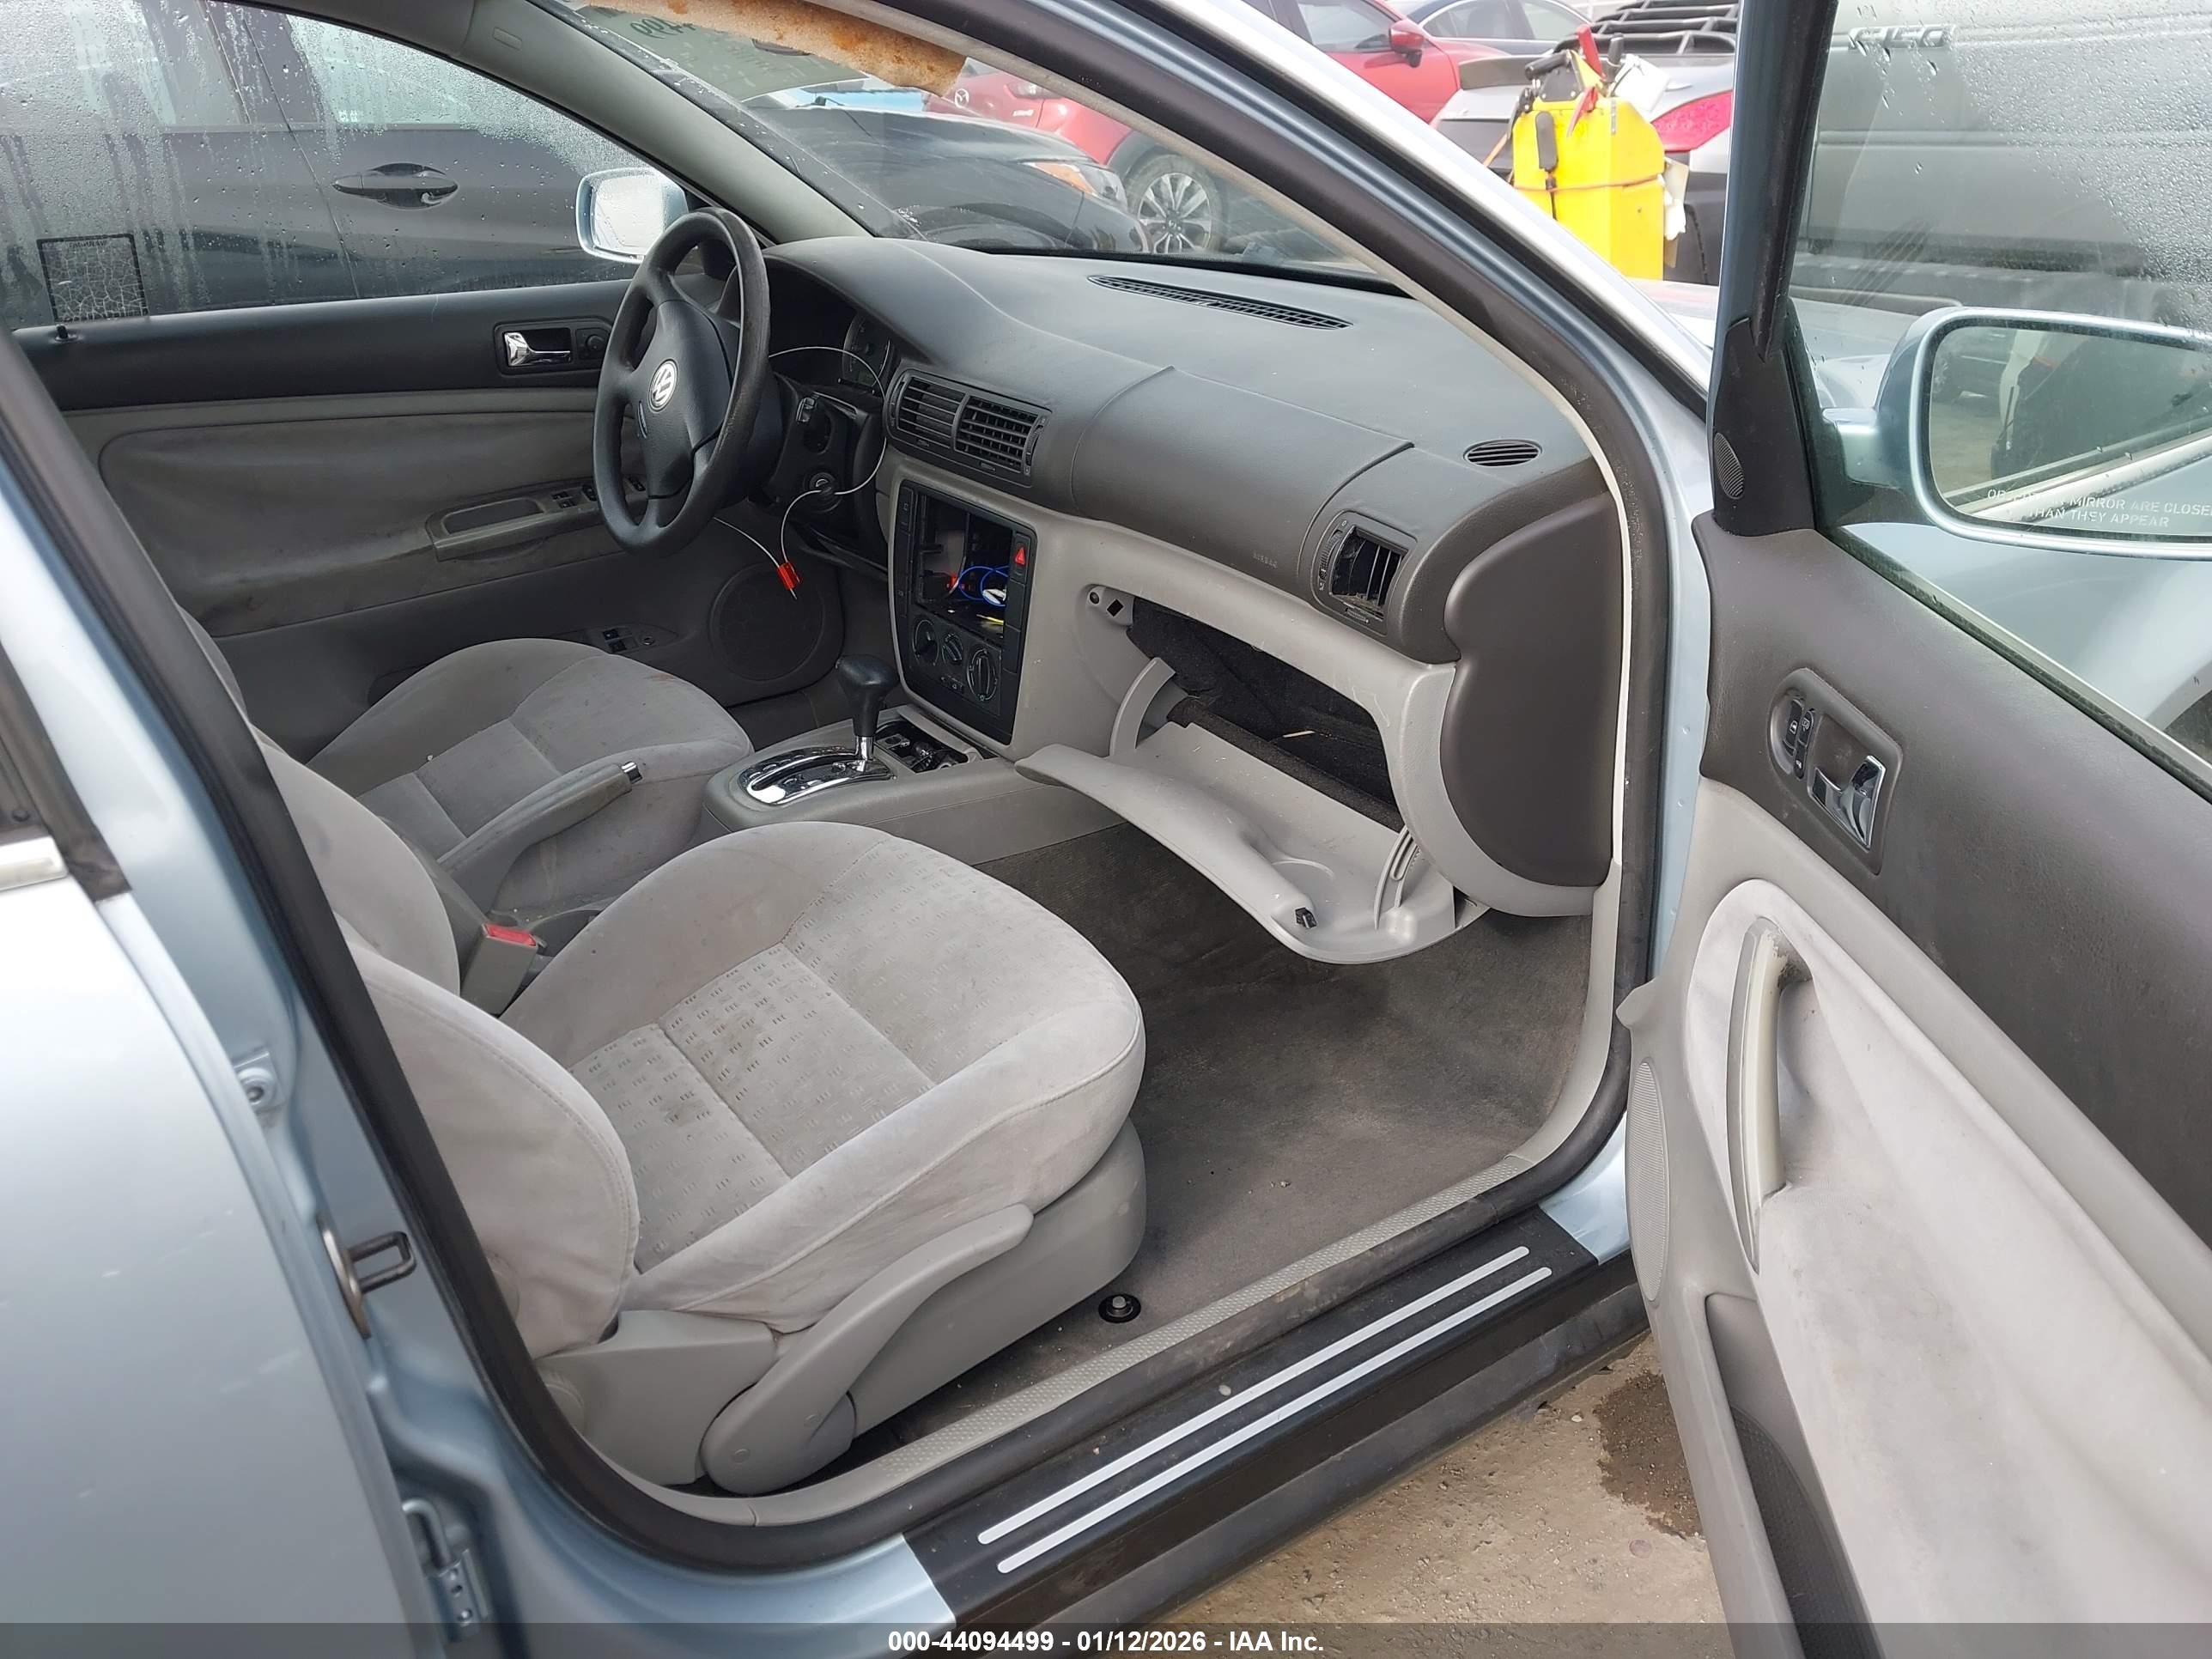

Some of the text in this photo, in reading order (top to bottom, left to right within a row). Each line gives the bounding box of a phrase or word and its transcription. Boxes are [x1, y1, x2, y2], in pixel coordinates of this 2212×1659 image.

[2069, 496, 2126, 511] MIRROR
[2130, 501, 2160, 513] ARE
[2070, 509, 2107, 522] THEY
[2110, 514, 2170, 528] APPEAR
